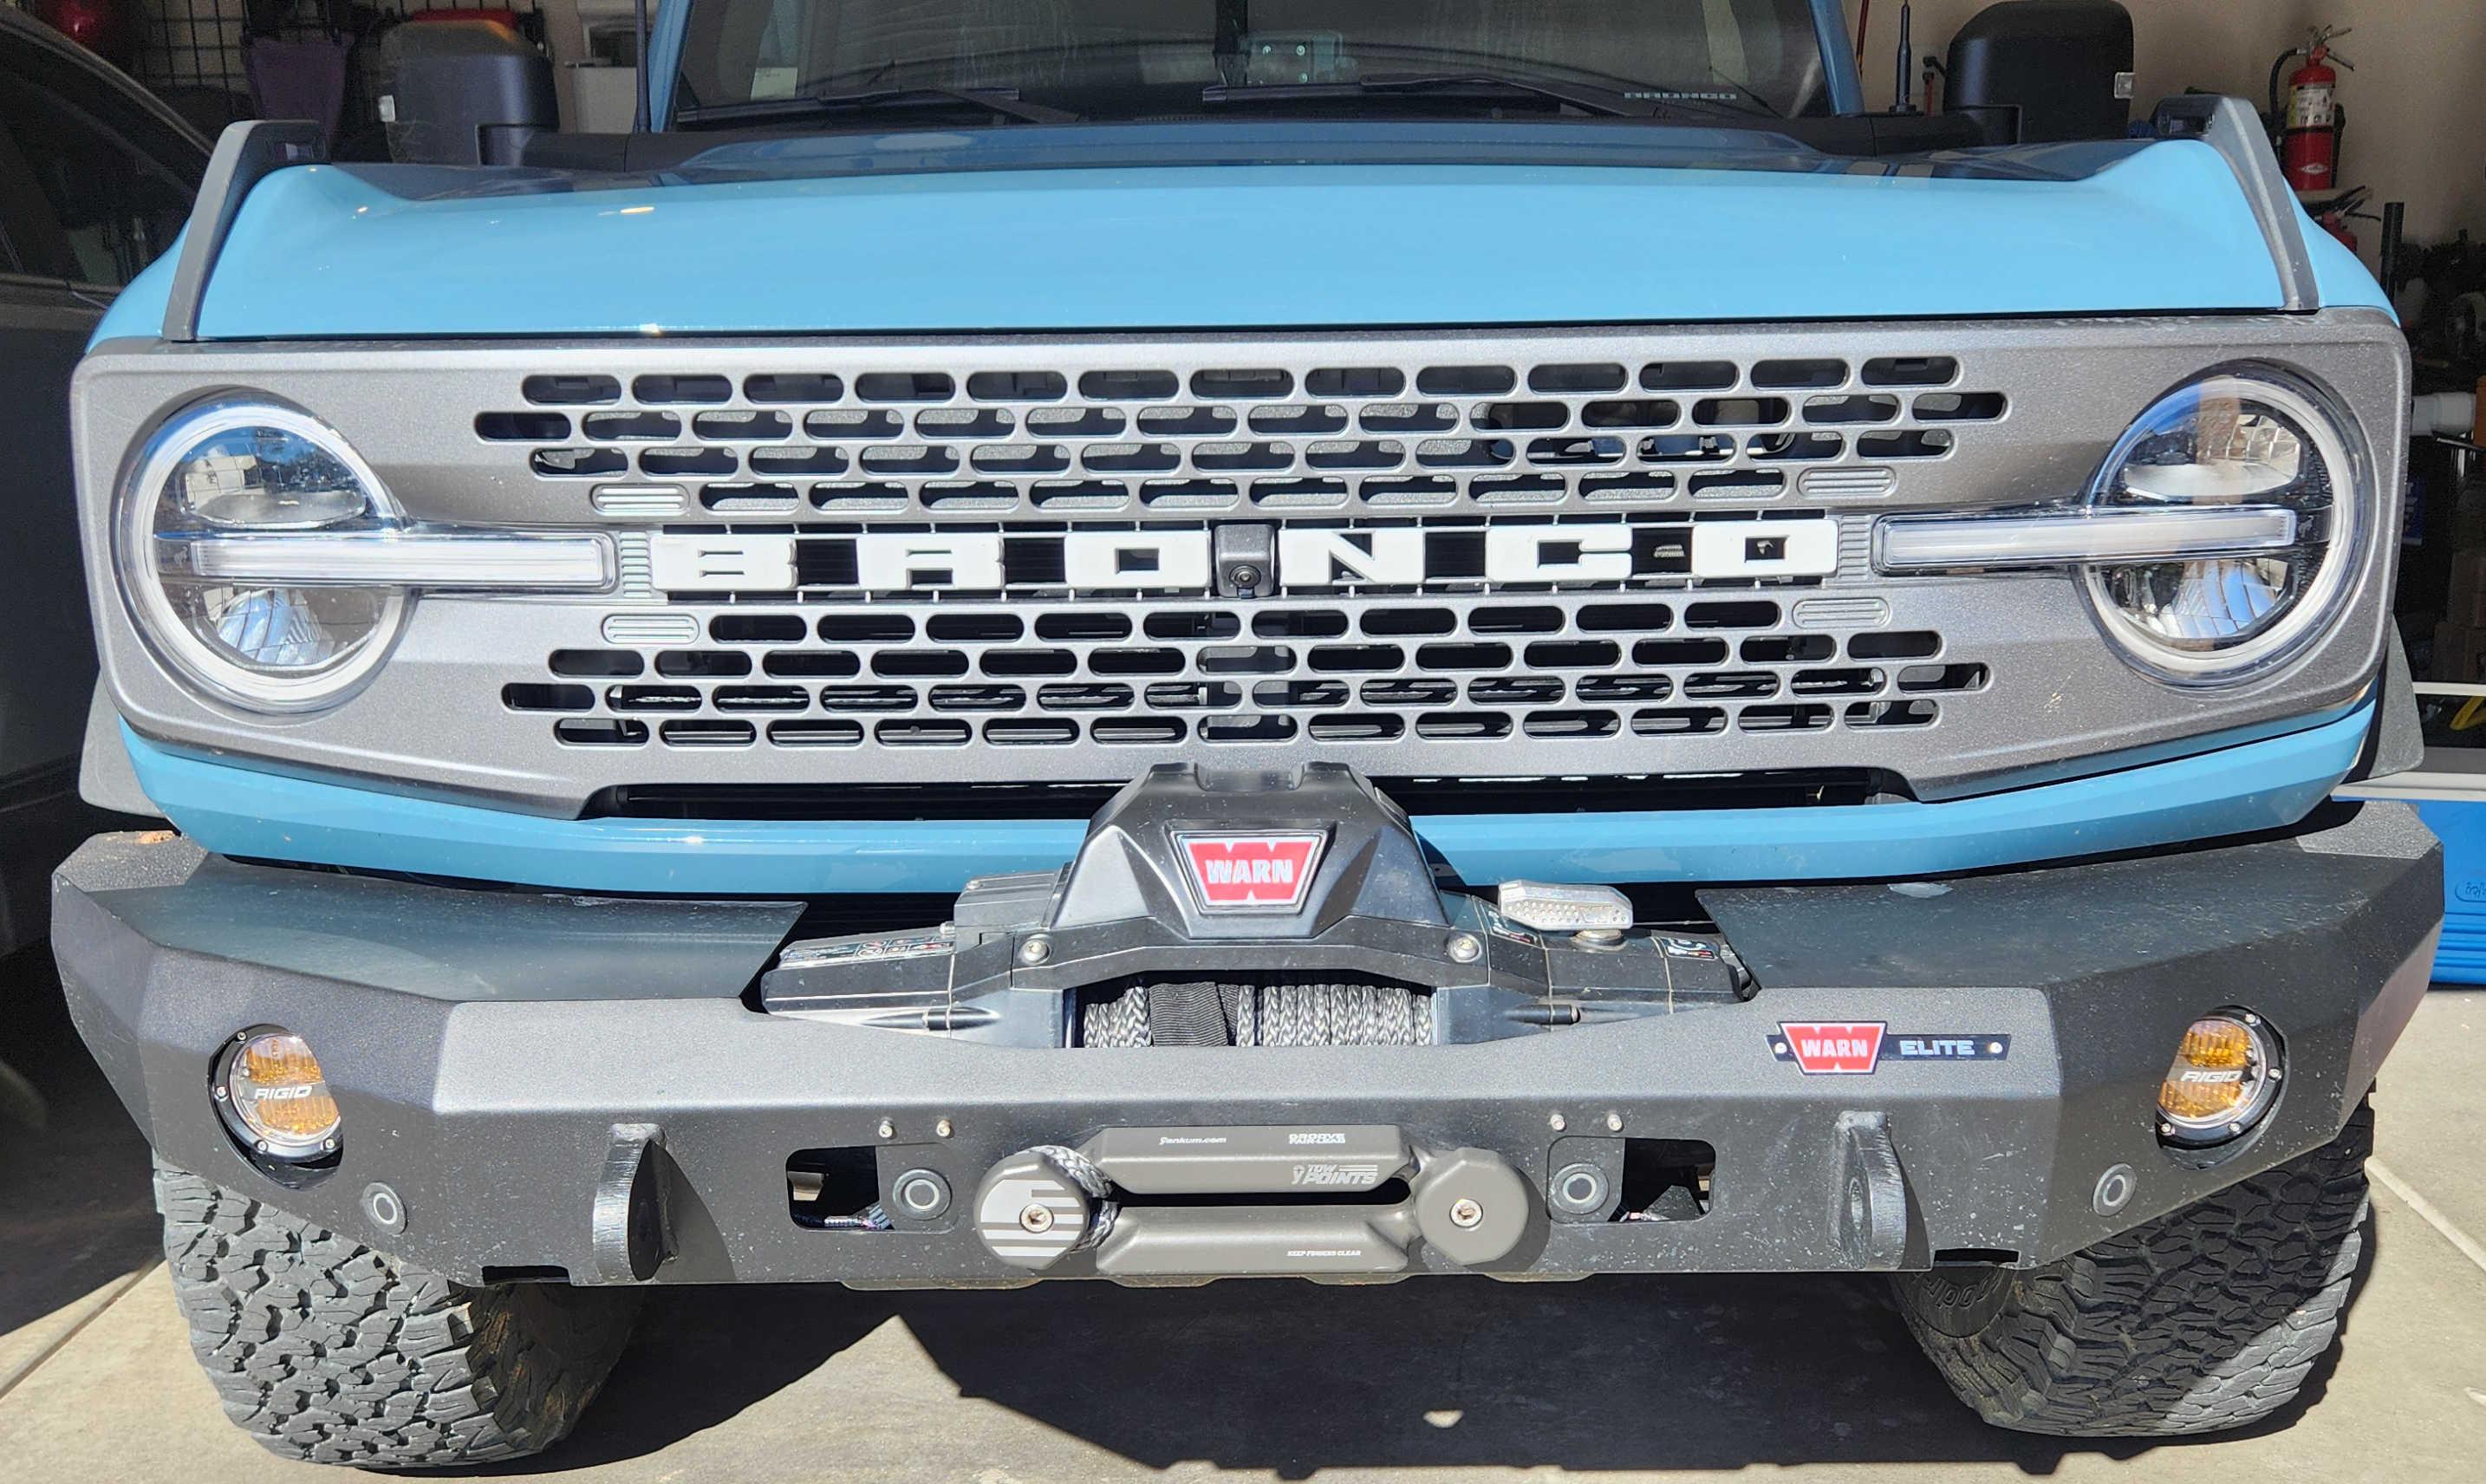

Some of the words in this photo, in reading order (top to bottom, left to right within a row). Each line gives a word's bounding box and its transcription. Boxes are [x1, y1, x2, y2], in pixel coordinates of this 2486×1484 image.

[649, 518, 1839, 591] BRONCO
[1204, 858, 1295, 884] WARN
[1800, 1038, 1868, 1058] WARN
[1899, 1039, 1975, 1056] ELITE
[2180, 1070, 2243, 1083] RIGID
[254, 1085, 313, 1100] RIGID
[1307, 1164, 1337, 1173] TOW
[1302, 1171, 1378, 1185] POINTS
